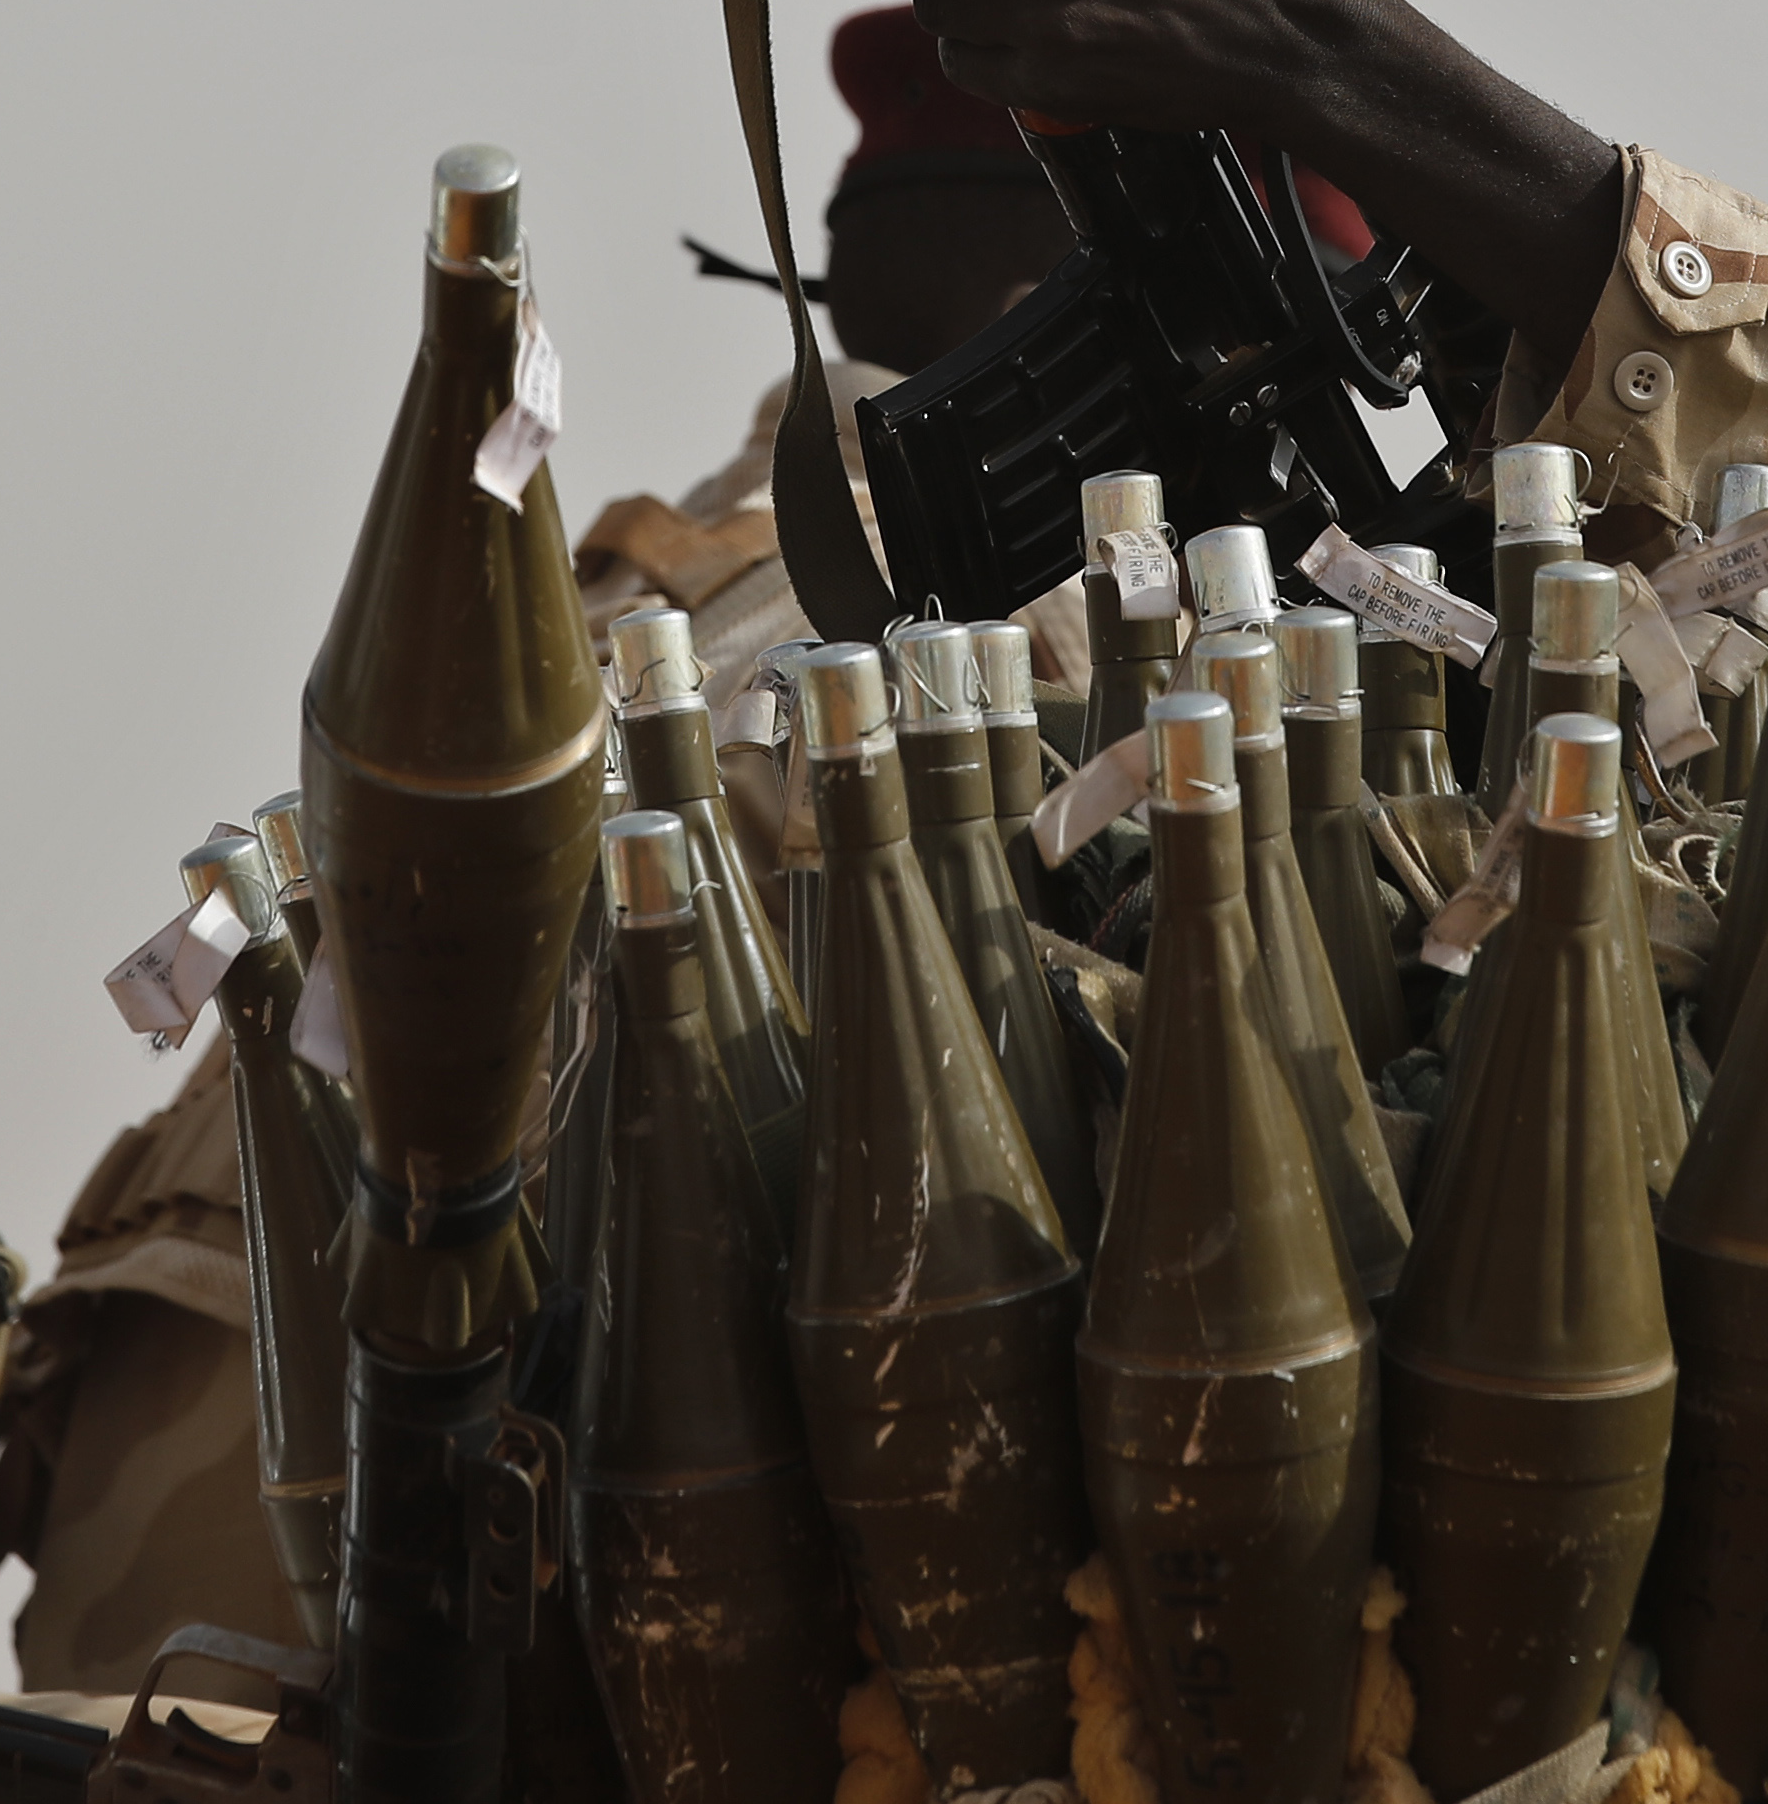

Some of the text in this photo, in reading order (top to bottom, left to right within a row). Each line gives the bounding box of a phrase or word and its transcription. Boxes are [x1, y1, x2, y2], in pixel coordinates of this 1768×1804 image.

[1128, 548, 1146, 587] FIRING
[1147, 554, 1163, 573] THE
[1701, 561, 1714, 576] TO
[1716, 541, 1761, 571] REMOVE
[1367, 572, 1447, 627] TO REMOVE THE
[1697, 584, 1716, 600] CAP
[1718, 566, 1762, 594] BEFORE
[1347, 584, 1449, 648] CAP BEFORE FIRING
